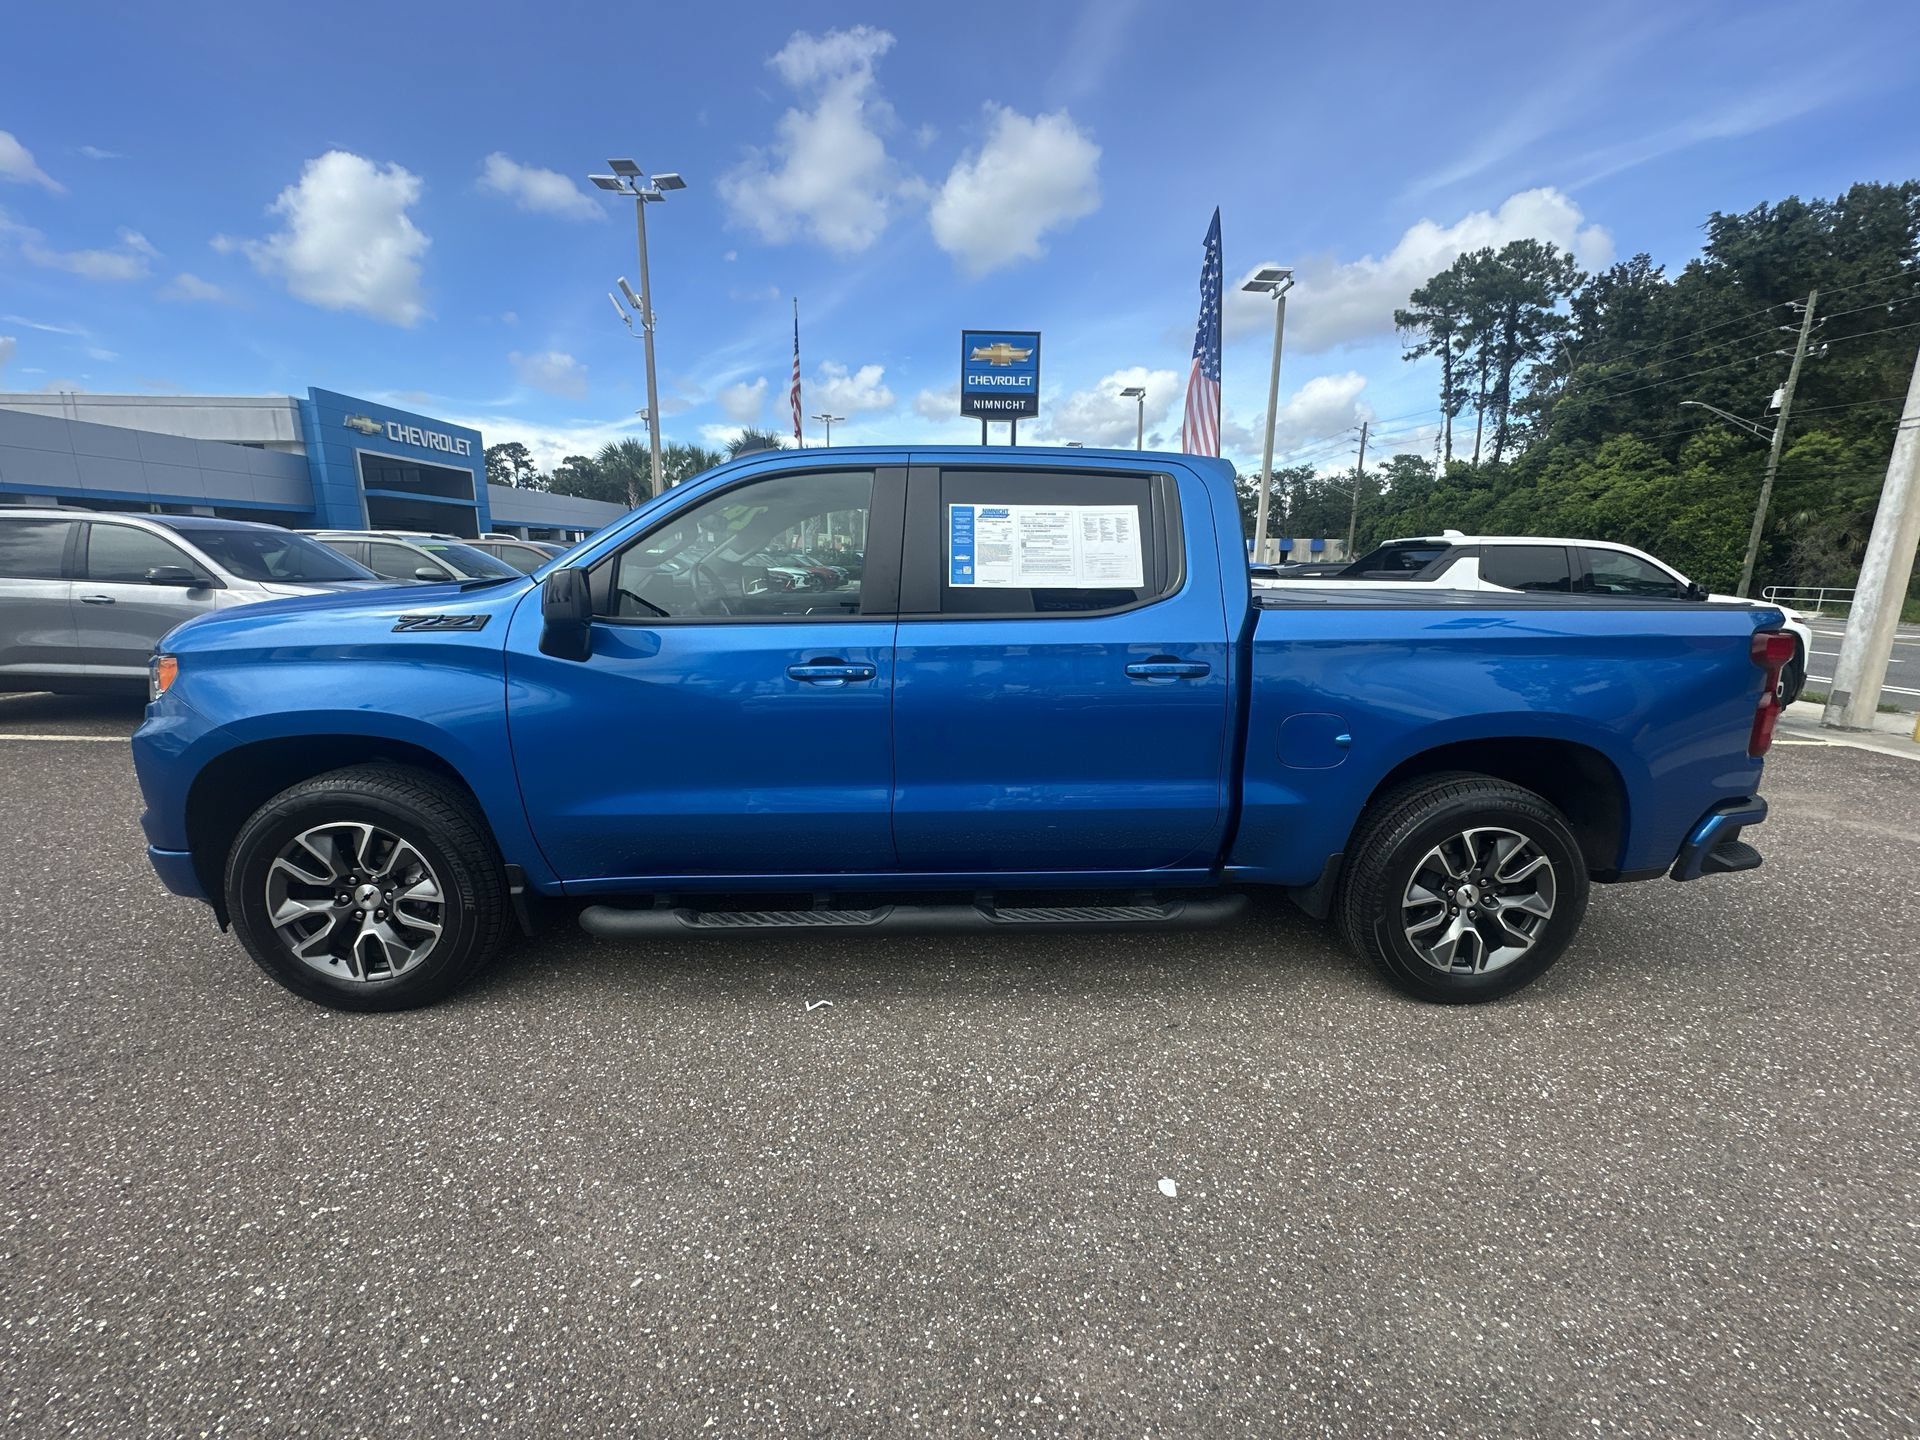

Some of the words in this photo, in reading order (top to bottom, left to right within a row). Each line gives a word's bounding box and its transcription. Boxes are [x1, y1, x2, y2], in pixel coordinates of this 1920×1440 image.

[968, 375, 1032, 386] CHEVROLET
[973, 399, 1026, 410] NIMNICHT
[386, 421, 472, 456] CHEVROLET
[391, 614, 493, 632] Z71
